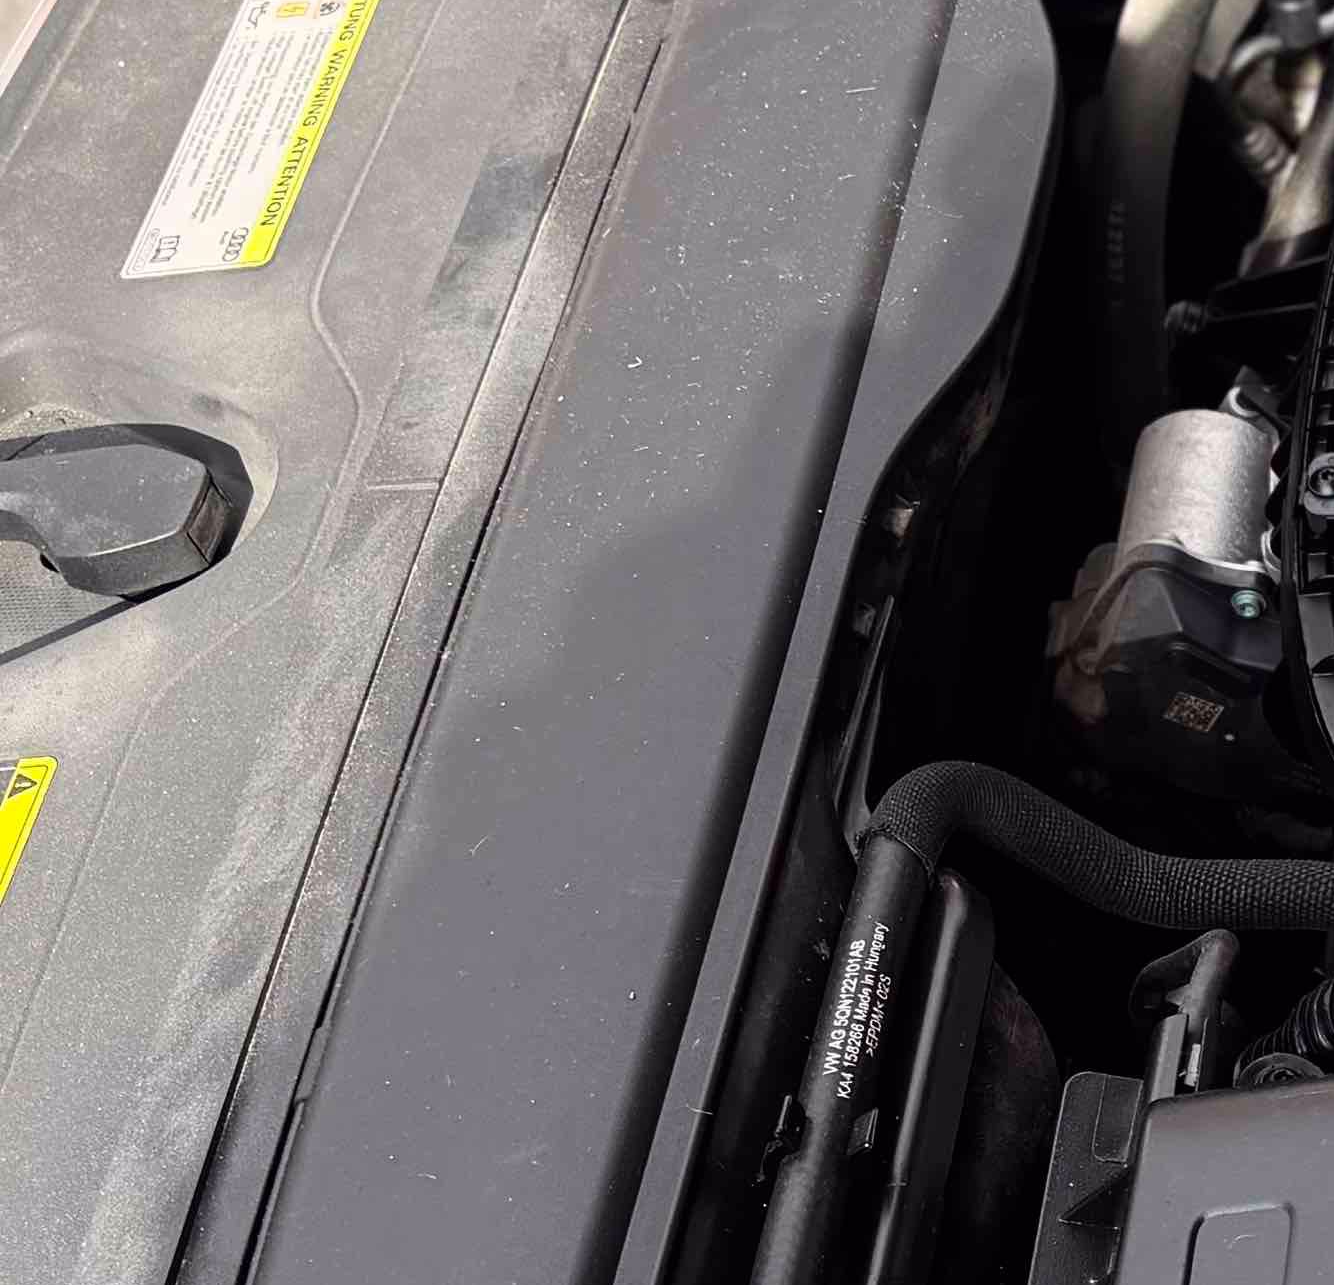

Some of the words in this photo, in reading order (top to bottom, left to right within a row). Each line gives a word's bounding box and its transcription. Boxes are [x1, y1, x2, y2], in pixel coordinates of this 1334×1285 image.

[302, 49, 346, 127] WARNING
[260, 137, 309, 227] ATTENTION
[863, 920, 889, 972] Hungary
[859, 975, 875, 983] in
[853, 987, 873, 1021] Made
[828, 1029, 847, 1049] AG
[822, 1052, 841, 1075] VW
[836, 1072, 854, 1098] KA4
